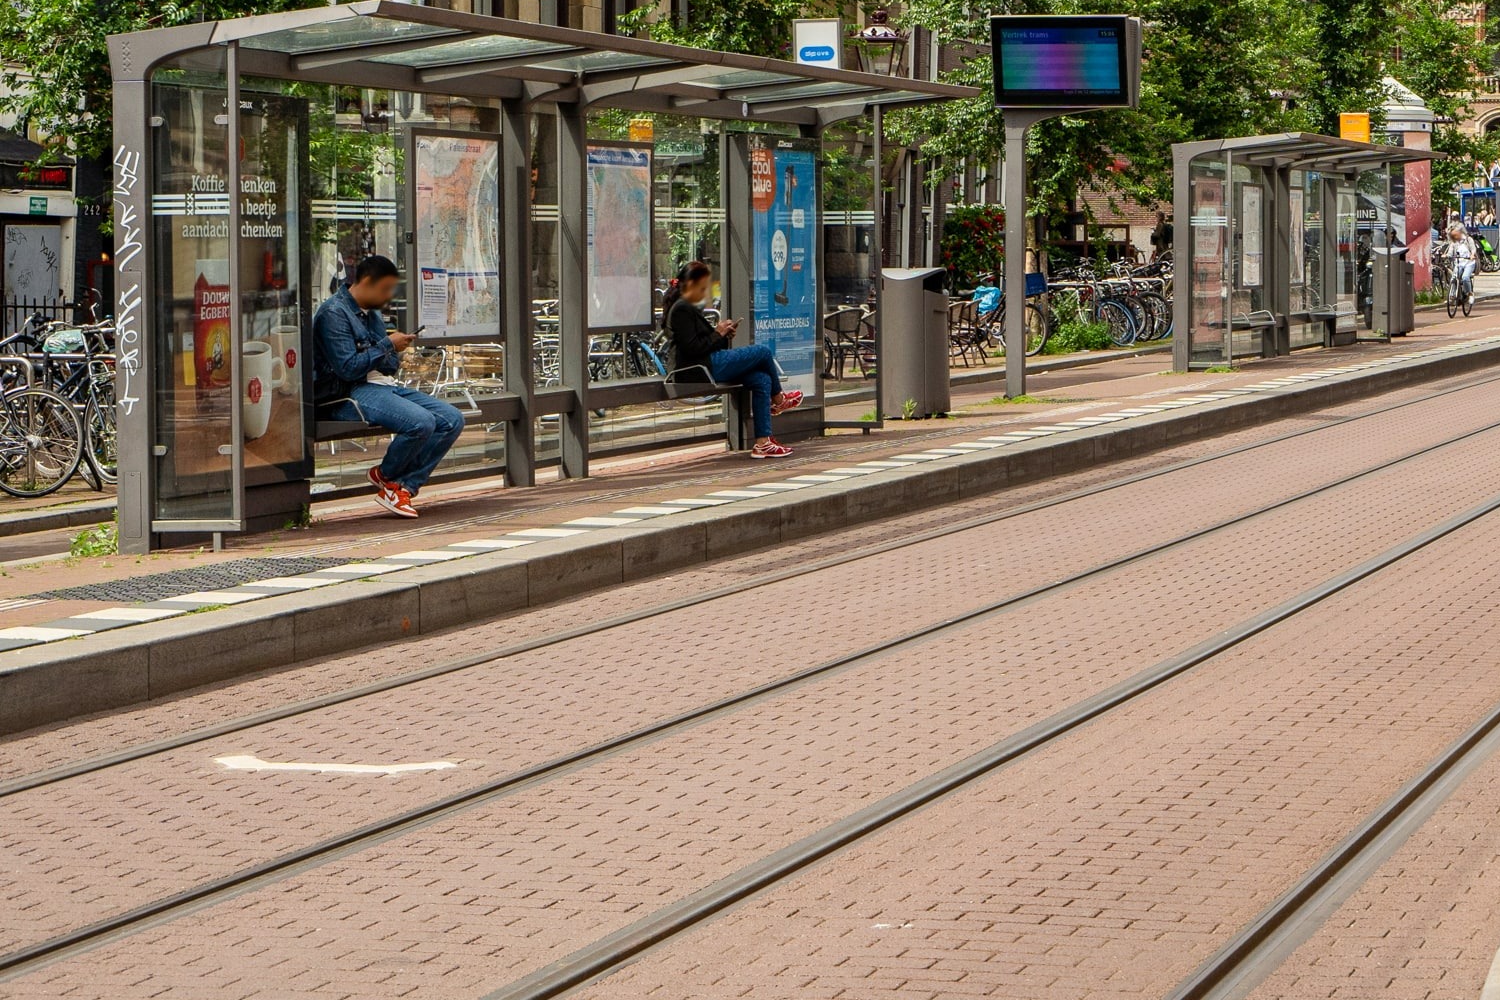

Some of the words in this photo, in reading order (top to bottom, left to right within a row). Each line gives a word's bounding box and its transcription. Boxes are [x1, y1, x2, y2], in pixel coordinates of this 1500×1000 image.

[752, 159, 771, 175] cool
[191, 174, 224, 192] Koffie
[752, 178, 772, 193] blue
[84, 204, 101, 216] 242
[246, 198, 277, 218] beetje
[182, 221, 229, 238] aandach
[241, 220, 283, 238] chenken
[202, 291, 230, 305] DOUW
